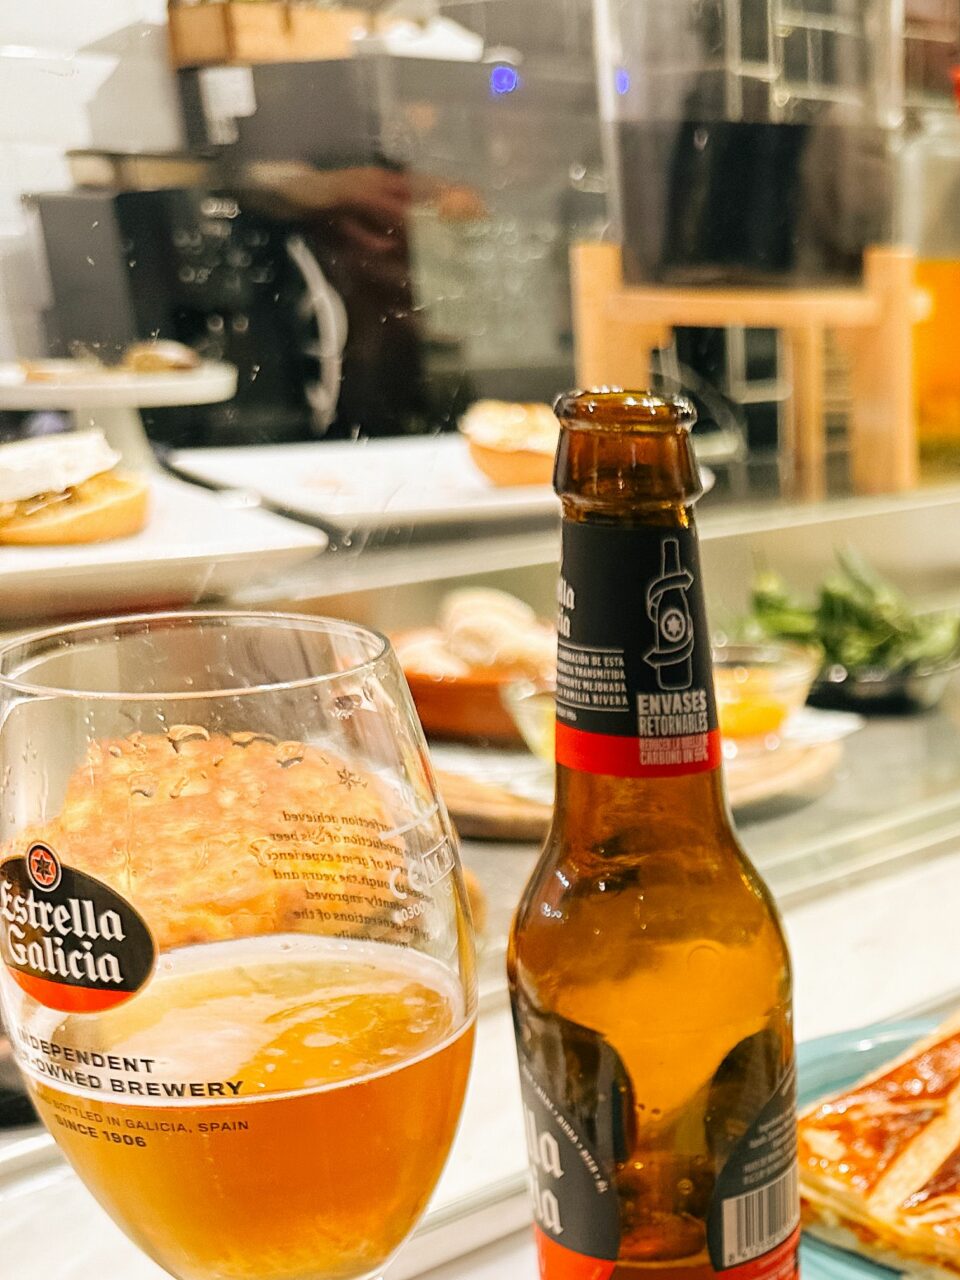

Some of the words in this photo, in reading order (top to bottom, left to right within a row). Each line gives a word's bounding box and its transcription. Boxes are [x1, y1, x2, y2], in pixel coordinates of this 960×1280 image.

[575, 666, 626, 680] TRANSMITIDA
[582, 681, 627, 693] MEJORADA
[592, 694, 629, 706] RIVERA
[637, 690, 707, 716] ENVASES
[639, 712, 709, 737] RETORNABLES
[0, 879, 127, 942] Estrella
[8, 923, 125, 985] Galicia
[18, 1027, 156, 1074] INDEPENDENT
[110, 1078, 244, 1098] BREWERY
[53, 1100, 104, 1124] BOTTLED
[106, 1115, 121, 1128] IN
[197, 1120, 249, 1134] SPAIN
[54, 1113, 99, 1139] SINCE
[101, 1130, 148, 1148] 1906
